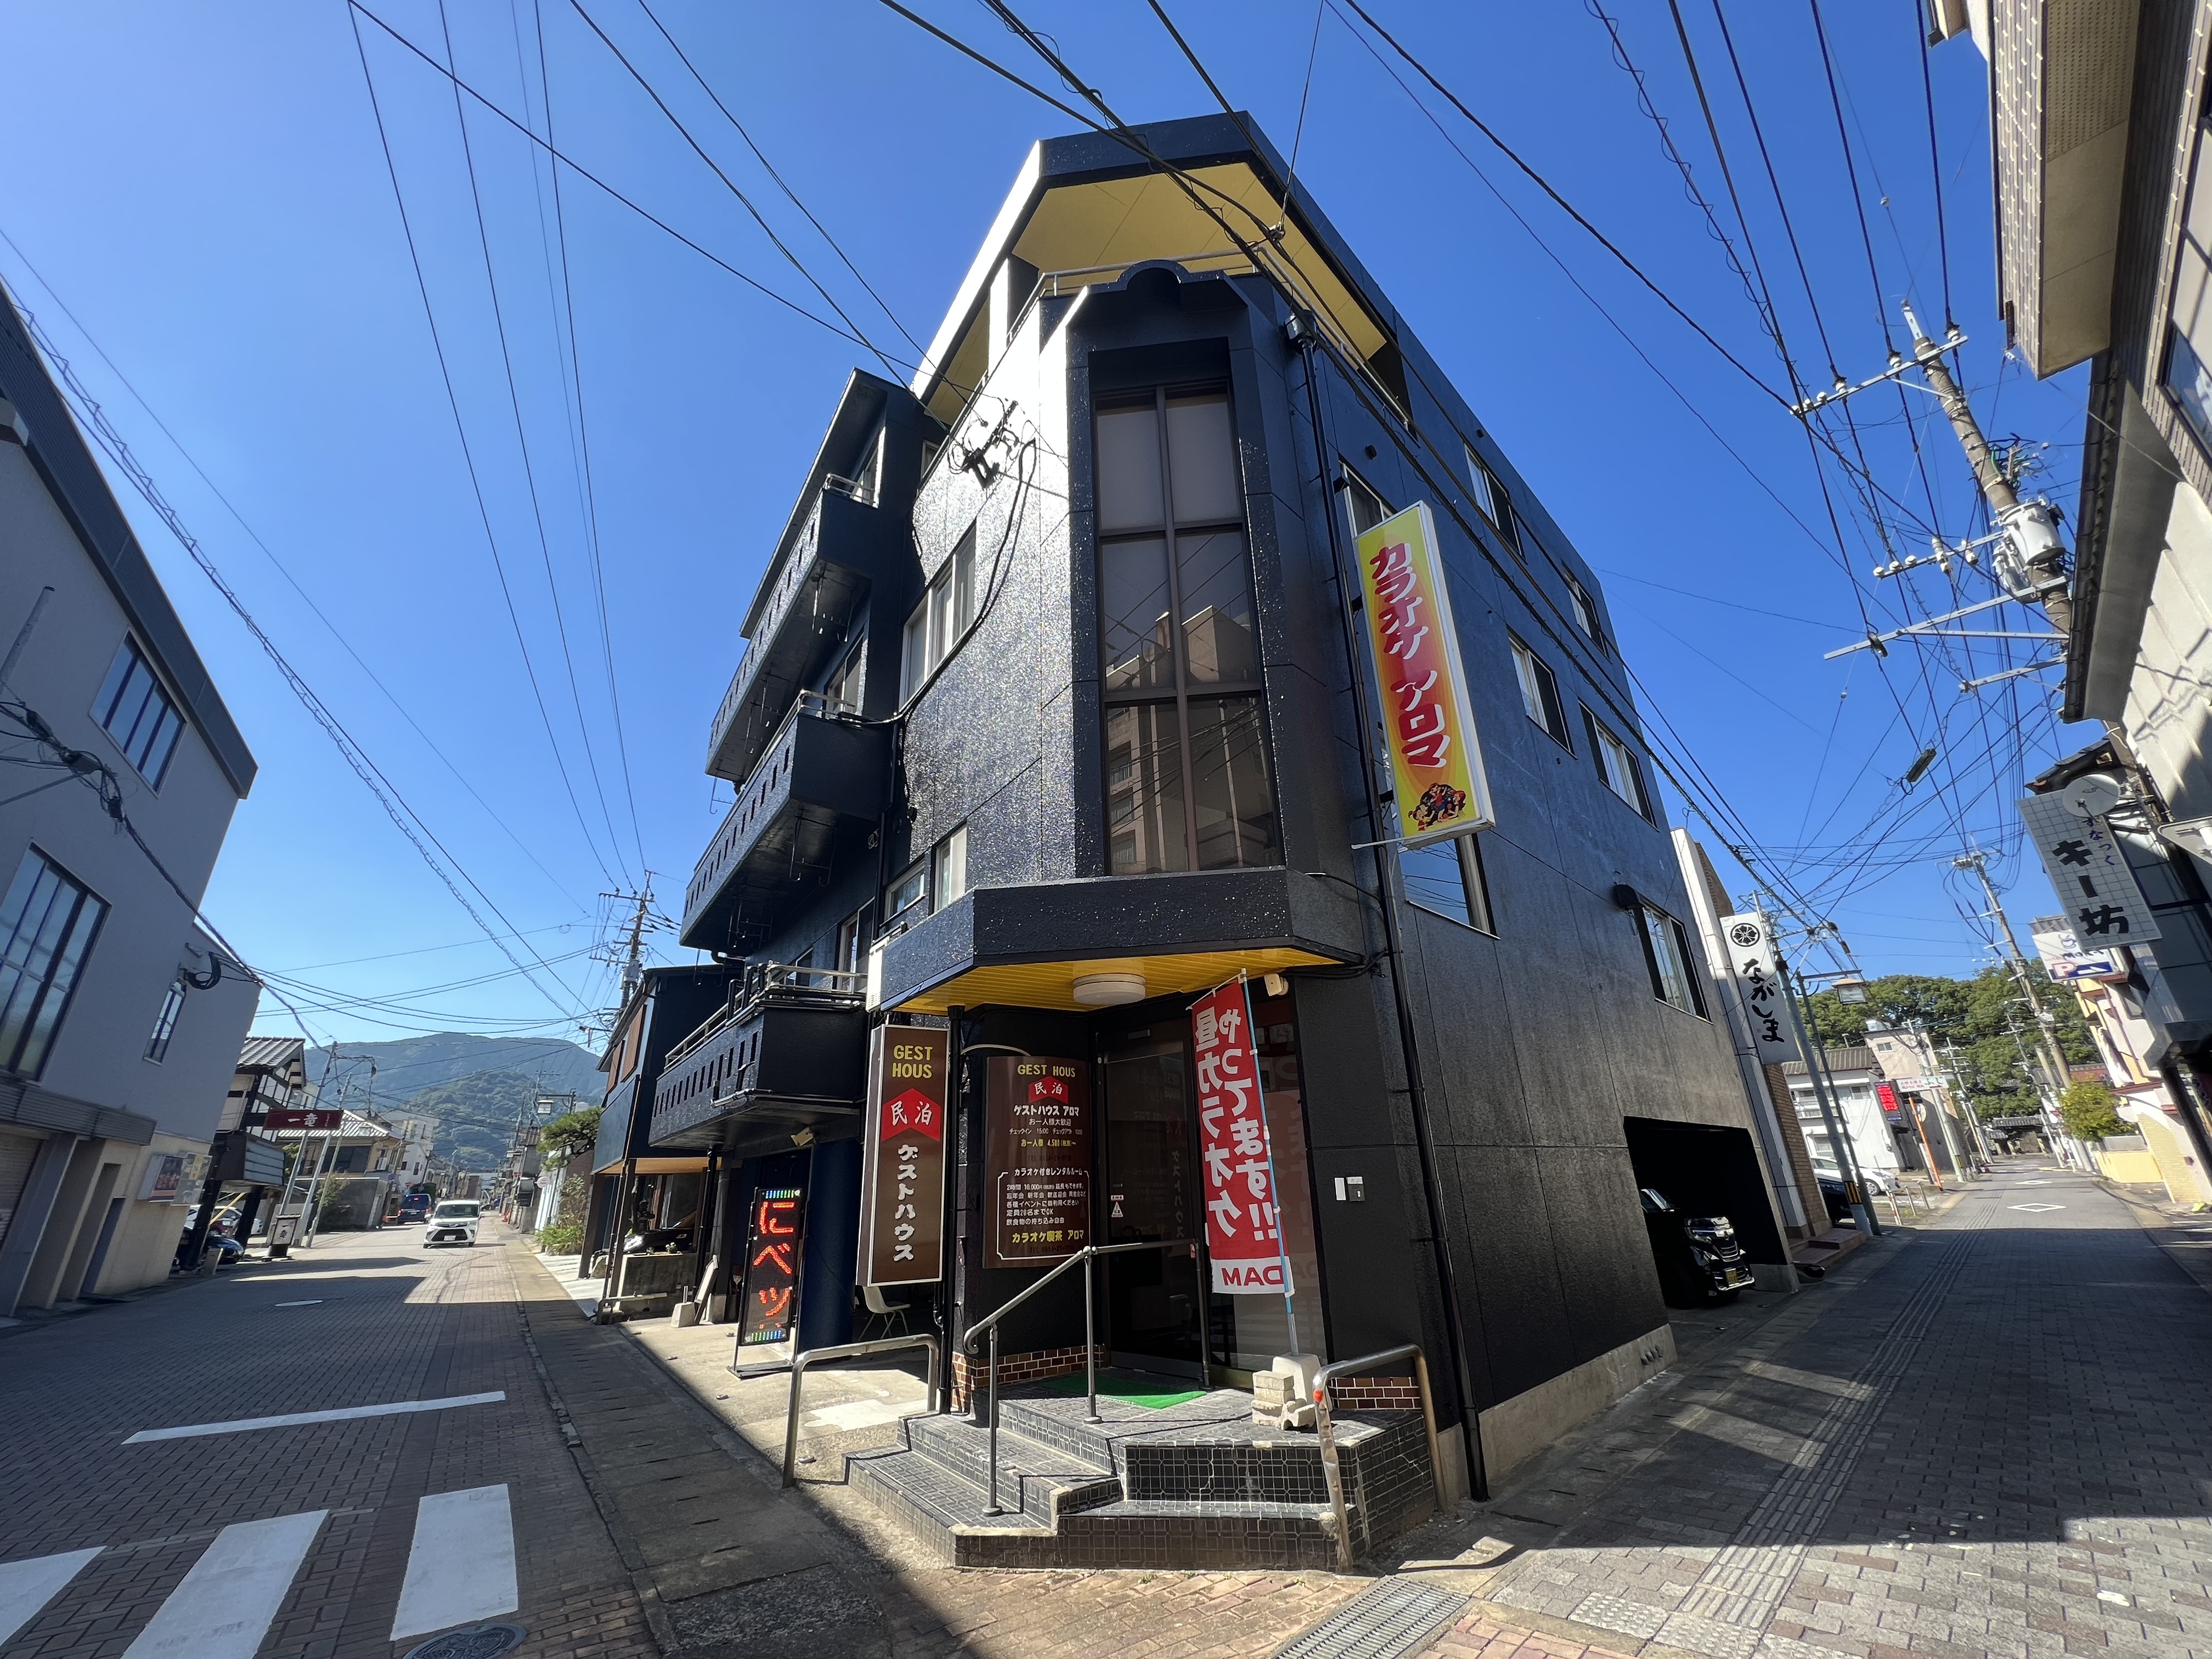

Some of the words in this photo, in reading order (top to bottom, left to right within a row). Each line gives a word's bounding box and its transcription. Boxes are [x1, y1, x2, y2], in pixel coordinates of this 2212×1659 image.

[1370, 543, 1429, 661] カラオケ
[1390, 670, 1451, 768] アロマ
[2052, 840, 2129, 936] キー坊
[2052, 962, 2076, 979] P
[1742, 958, 1785, 1043] ながしま
[893, 1045, 933, 1060] GEST
[892, 1063, 933, 1079] HOUS
[1017, 1064, 1047, 1075] GEST
[1053, 1066, 1075, 1077] HOUS
[1924, 1076, 1944, 1085] ふじ
[1034, 1082, 1063, 1095] 民泊
[890, 1100, 932, 1126] 民泊
[1014, 1105, 1059, 1116] ゲストハウス
[1063, 1105, 1079, 1116] アロマ
[288, 1113, 318, 1127] 一竜
[1029, 1118, 1071, 1126] お一人様大歓迎
[1014, 1167, 1082, 1177] カラオケ付きレンタルルーム
[893, 1144, 919, 1262] ゲストハウス
[1006, 1208, 1054, 1217] 定員20名までOK
[1006, 1217, 1065, 1226] 飲食物の持ち込み自由
[1012, 1231, 1063, 1243] カラオケ喫茶
[1068, 1230, 1084, 1240] アロマ
